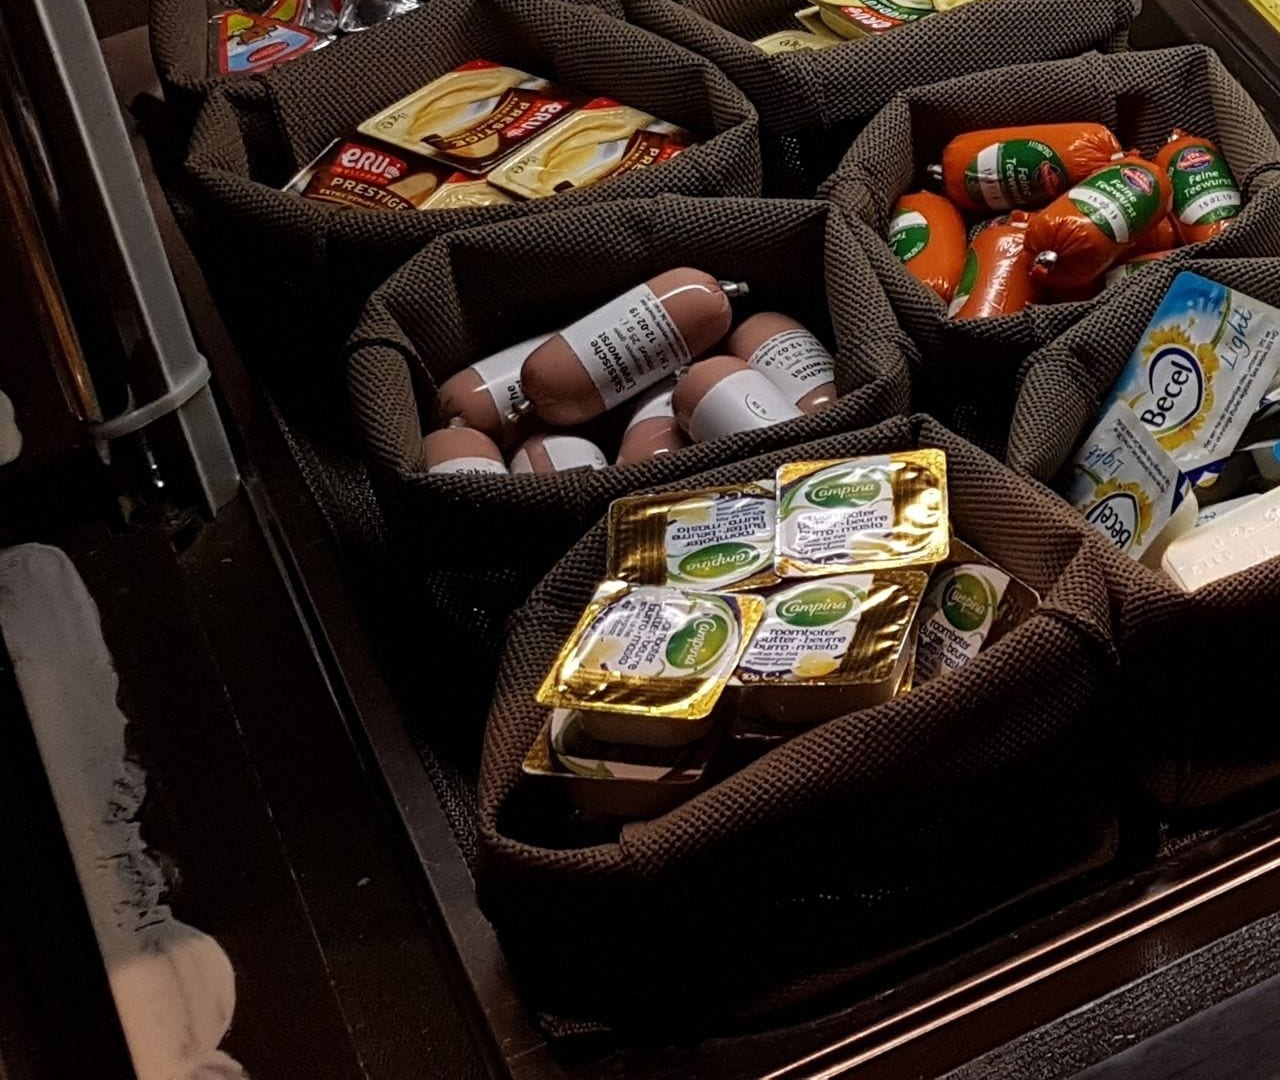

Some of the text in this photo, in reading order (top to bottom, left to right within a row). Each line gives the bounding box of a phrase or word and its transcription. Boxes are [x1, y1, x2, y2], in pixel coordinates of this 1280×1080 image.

[451, 102, 531, 148] PRESTIGE
[1184, 178, 1233, 198] Teewurst
[1188, 171, 1219, 185] Feine
[330, 177, 409, 211] PRESTIGE
[1095, 180, 1137, 218] Teewurst
[1110, 178, 1137, 203] Feine
[1220, 304, 1252, 370] Light
[1140, 360, 1194, 428] Becel
[1084, 444, 1124, 476] Light
[811, 481, 875, 502] Campina
[846, 515, 888, 526] beurre
[1091, 502, 1132, 550] Becel
[671, 530, 717, 541] beurre
[684, 530, 755, 548] roomboter
[685, 548, 755, 572] Campina
[782, 598, 847, 617] Campina
[684, 619, 717, 665] Campina
[769, 628, 840, 637] roomboter
[803, 635, 846, 645] beurre
[929, 619, 972, 650] roomboter
[754, 642, 789, 651] burro
